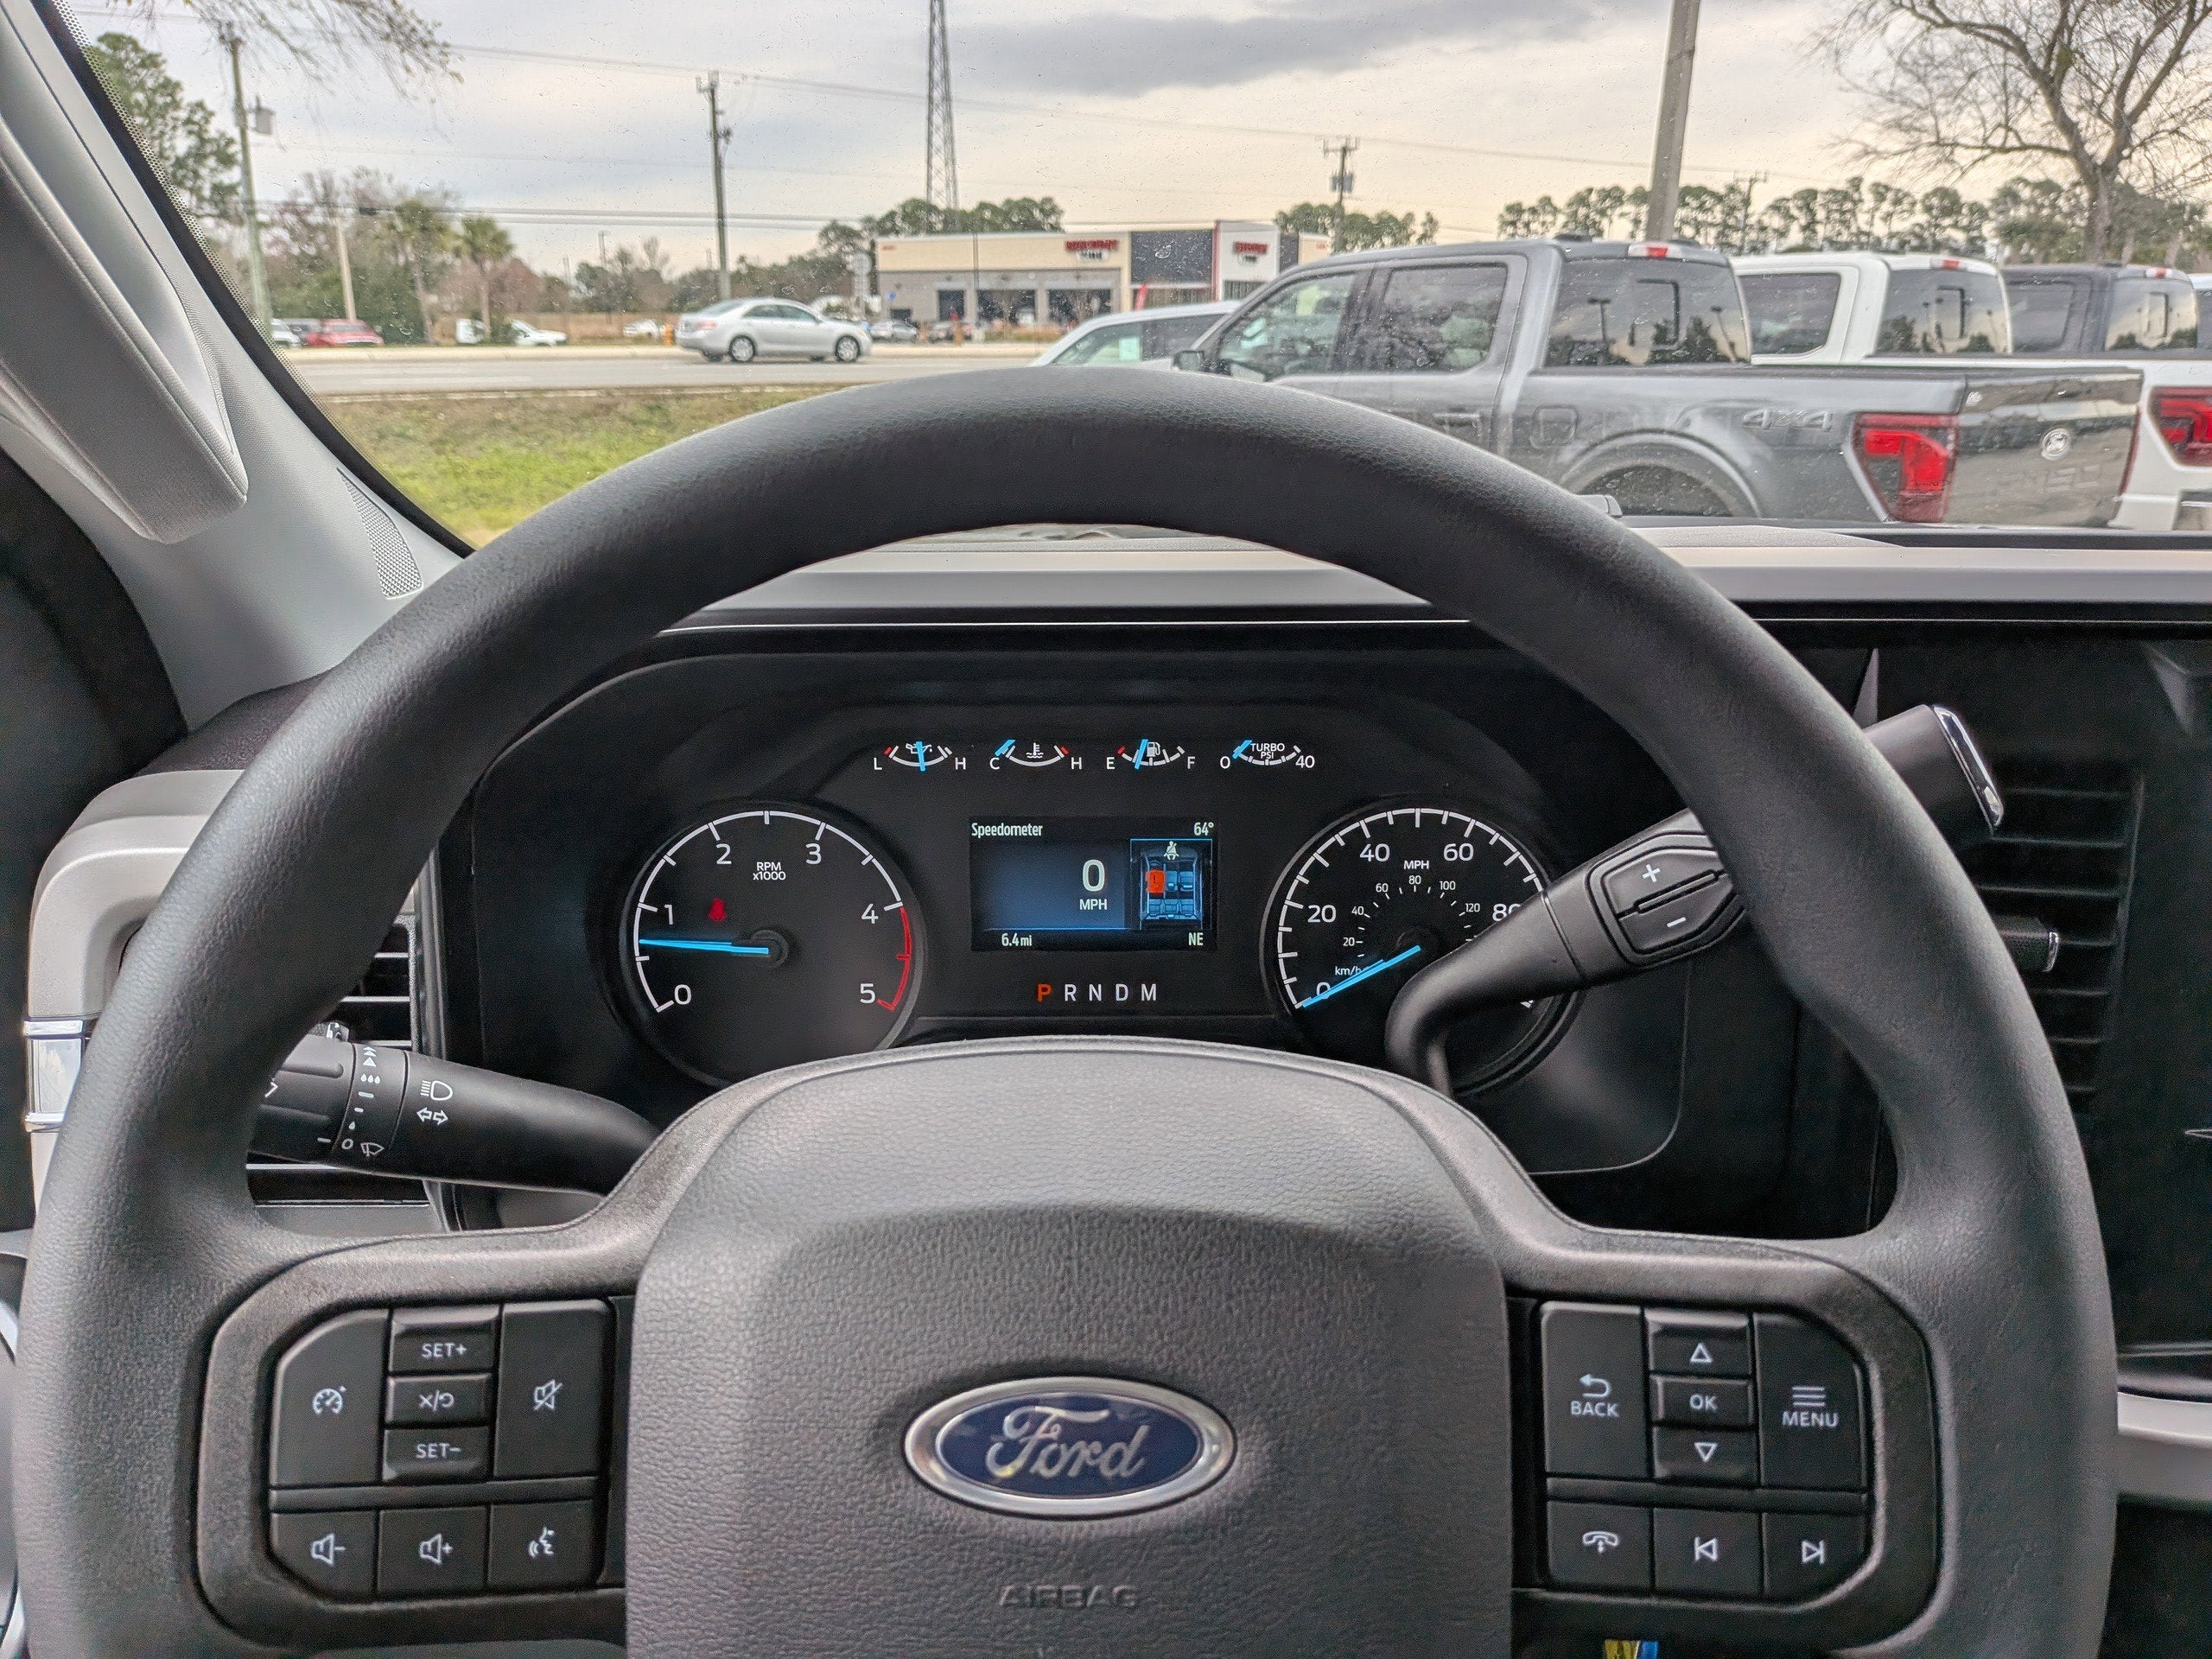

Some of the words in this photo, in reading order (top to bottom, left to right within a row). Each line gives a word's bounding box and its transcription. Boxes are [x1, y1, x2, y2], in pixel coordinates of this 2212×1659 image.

[1250, 743, 1285, 752] TURBO
[874, 758, 882, 770] L
[955, 758, 966, 770] H
[989, 755, 1000, 770] C
[1071, 757, 1082, 769] H
[1107, 757, 1115, 769] E
[1187, 756, 1195, 769] F
[1296, 755, 1315, 768] 40
[972, 823, 1043, 838] Speedometer
[716, 843, 732, 864] 2
[806, 843, 821, 864] 3
[1360, 843, 1389, 861] 40
[1444, 843, 1473, 861] 60
[757, 862, 781, 871] RPM
[1404, 861, 1429, 869] MPH
[1083, 860, 1105, 892] 0
[1408, 875, 1421, 884] 80
[1376, 883, 1388, 893] 60
[1440, 880, 1455, 890] 100
[1080, 899, 1107, 910] MPH
[1351, 906, 1364, 915] 40
[1465, 903, 1480, 912] 120
[664, 904, 673, 925] 1
[861, 904, 878, 924] 4
[1308, 905, 1336, 922] 20
[1001, 932, 1019, 946] 6.4
[1189, 932, 1204, 945] NE
[1343, 938, 1355, 946] 20
[675, 984, 691, 1005] 0
[861, 983, 875, 1003] 5
[1038, 984, 1052, 1001] P
[1065, 984, 1077, 1001] R
[1090, 984, 1102, 1001] N
[1116, 984, 1128, 1001] D
[1141, 984, 1156, 1001] M
[422, 1343, 467, 1359] SET+
[1571, 1401, 1619, 1418] BACK
[1689, 1394, 1718, 1411] OK
[1783, 1409, 1840, 1428] MENU
[986, 1406, 1150, 1478] Ford
[998, 1585, 1138, 1609] AIRBAG
